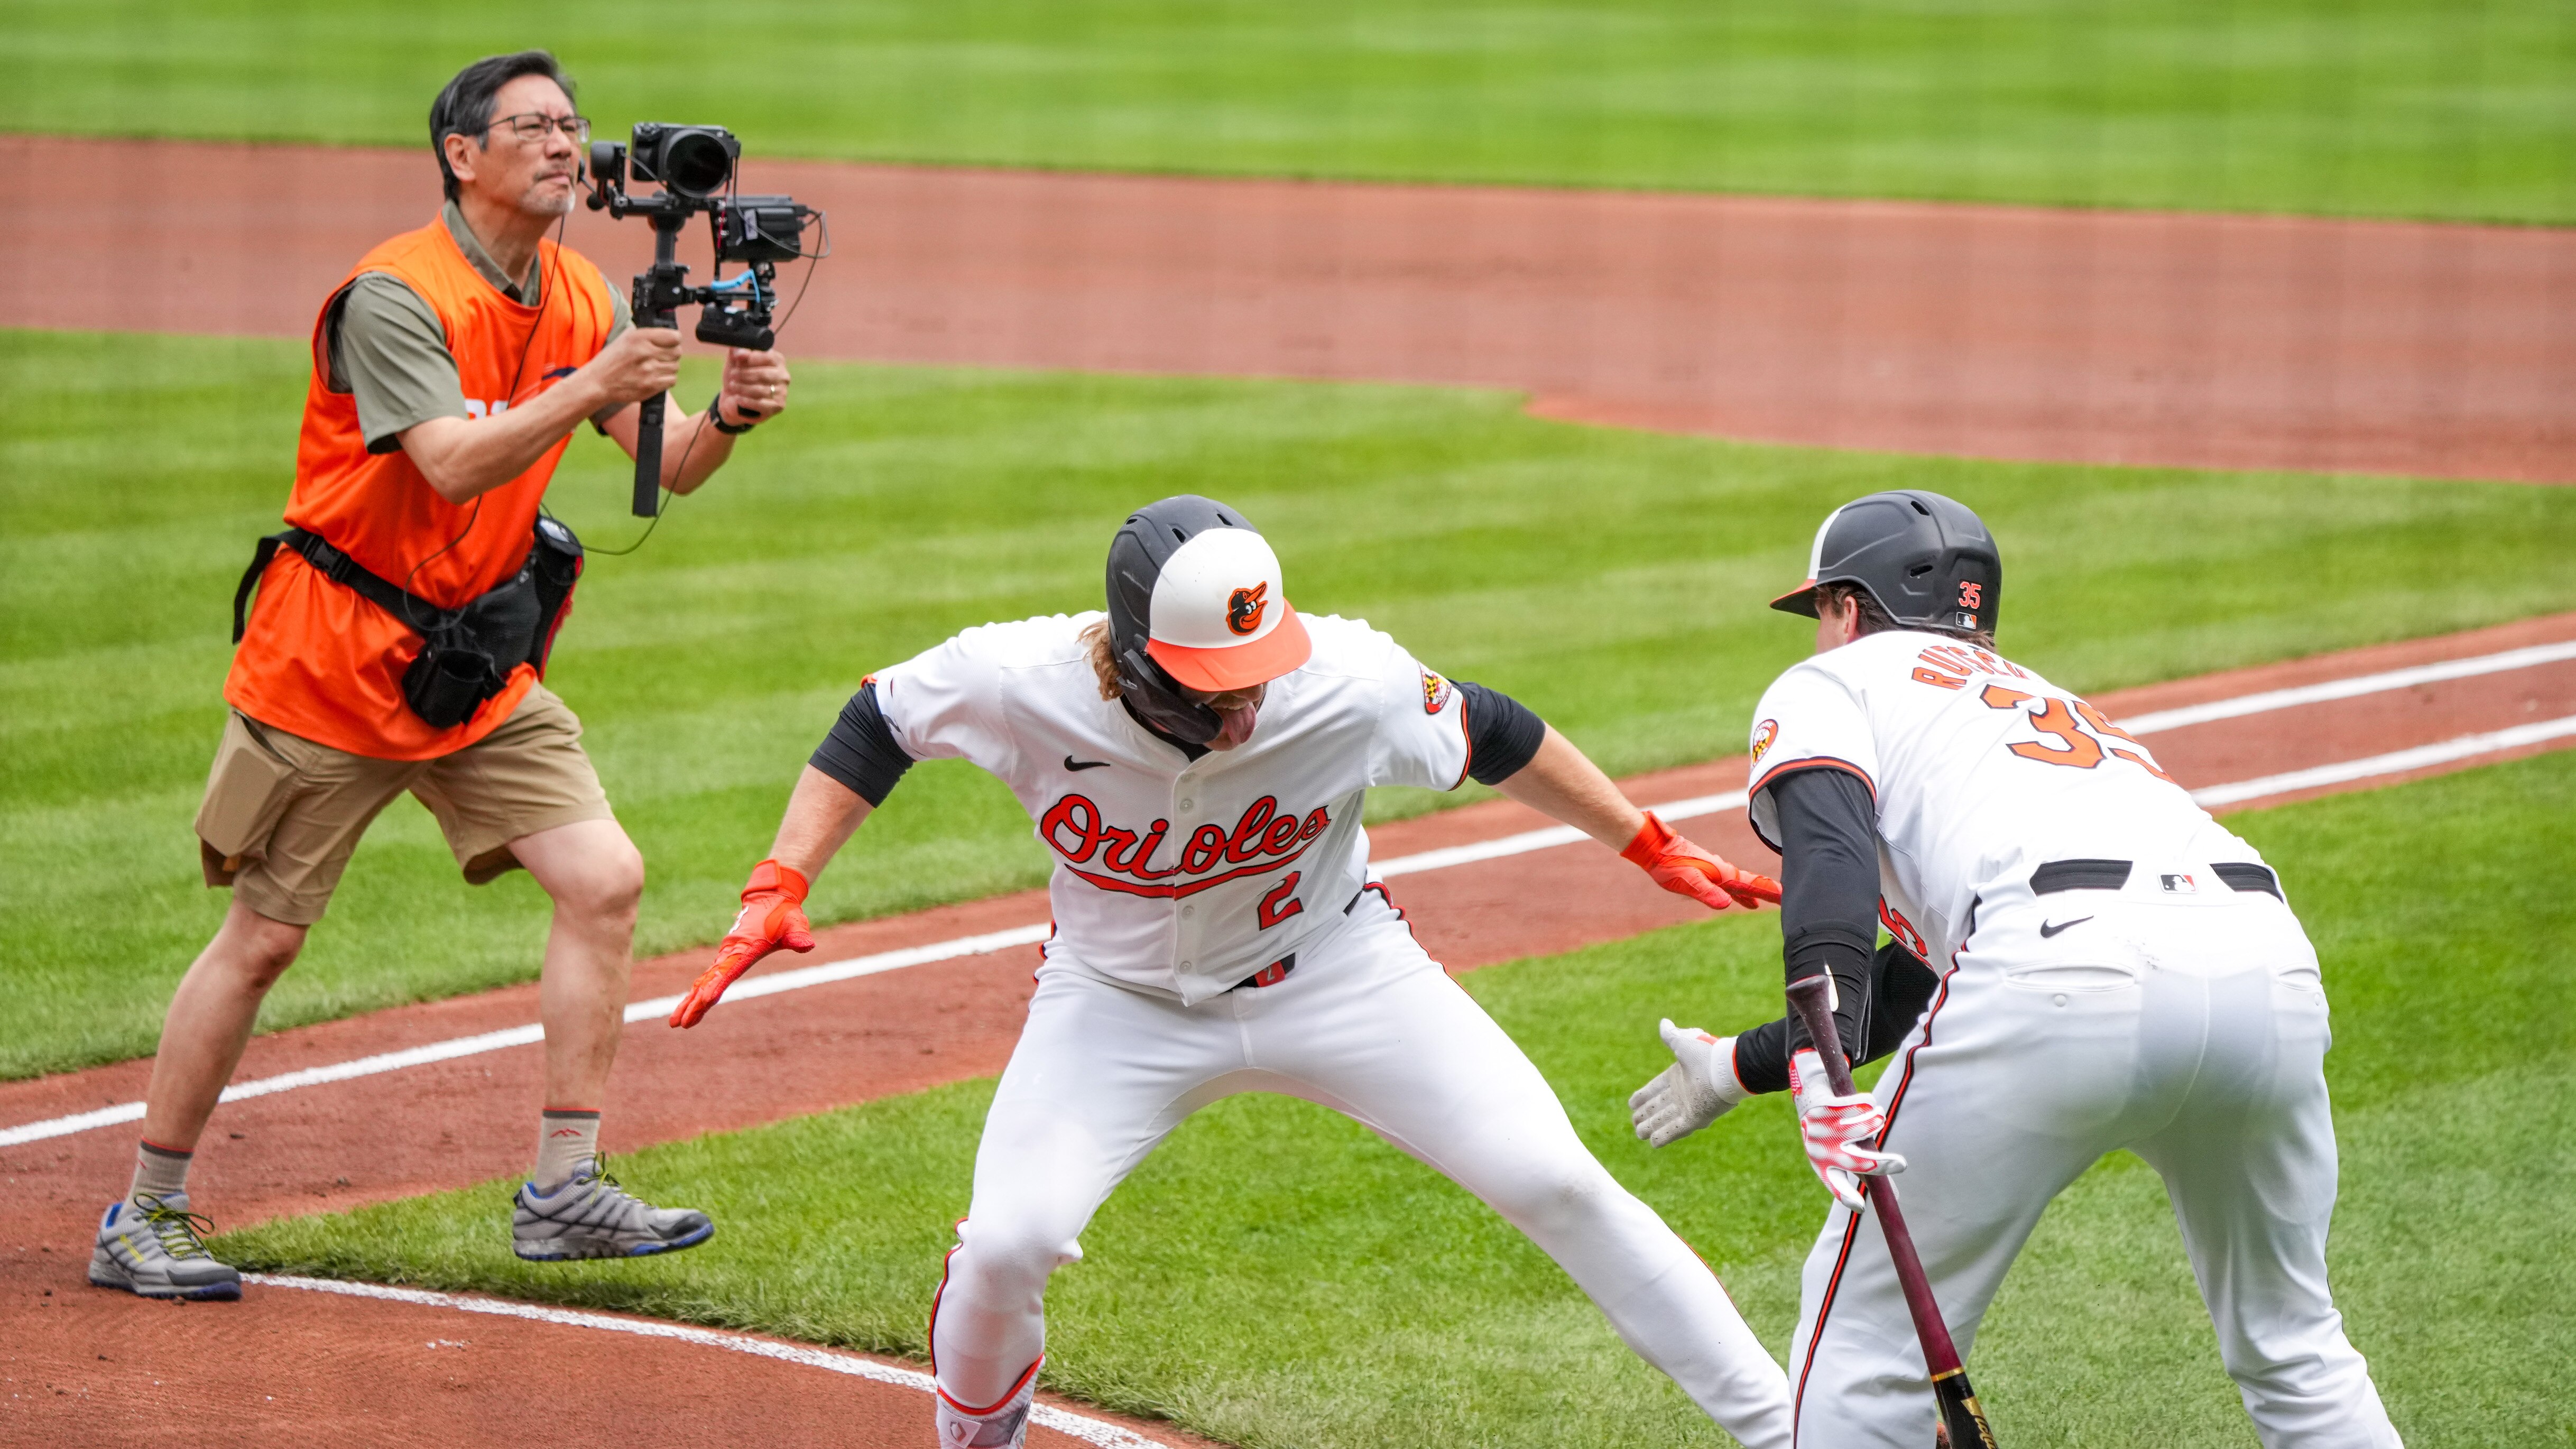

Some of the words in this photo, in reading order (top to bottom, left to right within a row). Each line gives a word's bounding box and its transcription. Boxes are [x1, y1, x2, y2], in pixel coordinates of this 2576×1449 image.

[1959, 581, 1981, 609] 35
[1979, 684, 2179, 785] 35
[1040, 793, 1332, 888] Orioles
[1257, 871, 1304, 931] 2
